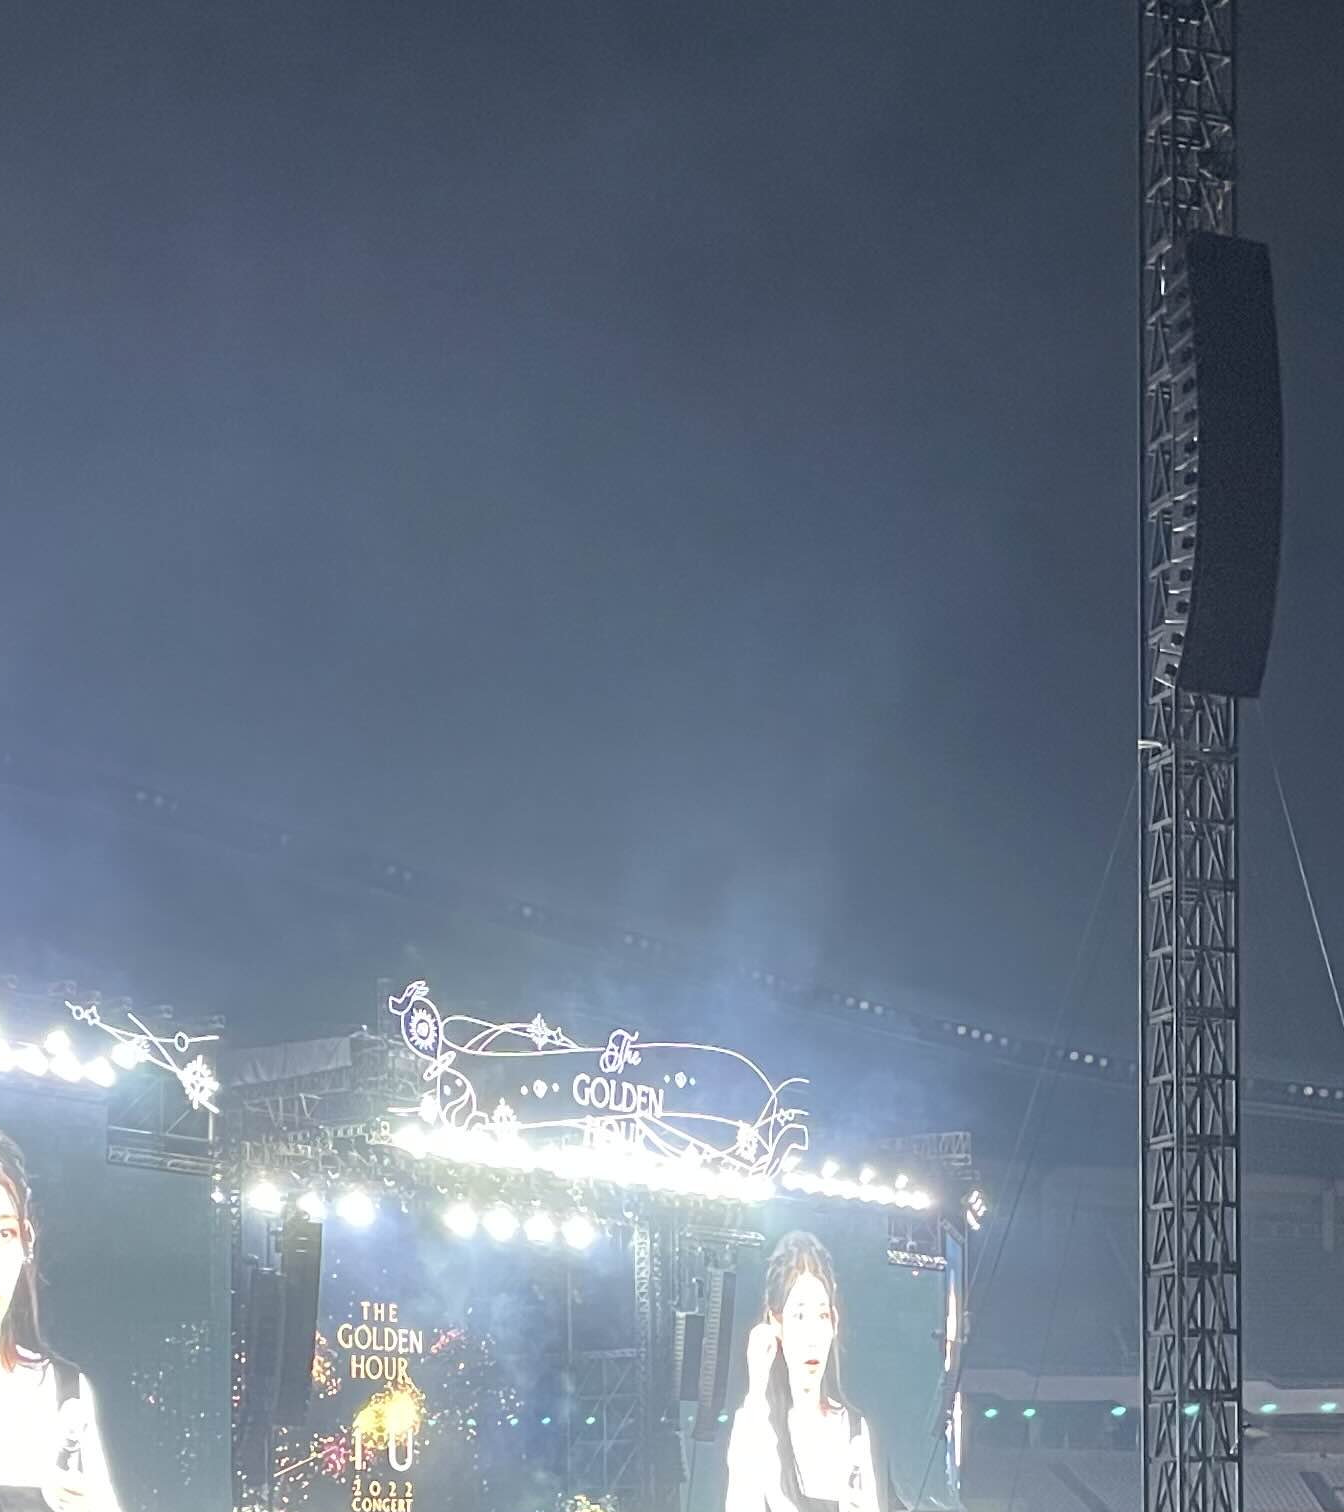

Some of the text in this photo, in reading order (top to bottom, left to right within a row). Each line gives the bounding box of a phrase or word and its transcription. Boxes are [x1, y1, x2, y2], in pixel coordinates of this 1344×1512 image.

[599, 1028, 642, 1074] The
[572, 1073, 664, 1118] GOLDEN
[360, 1301, 398, 1323] THE
[336, 1323, 423, 1354] GOLDEN
[350, 1355, 409, 1384] HOUR
